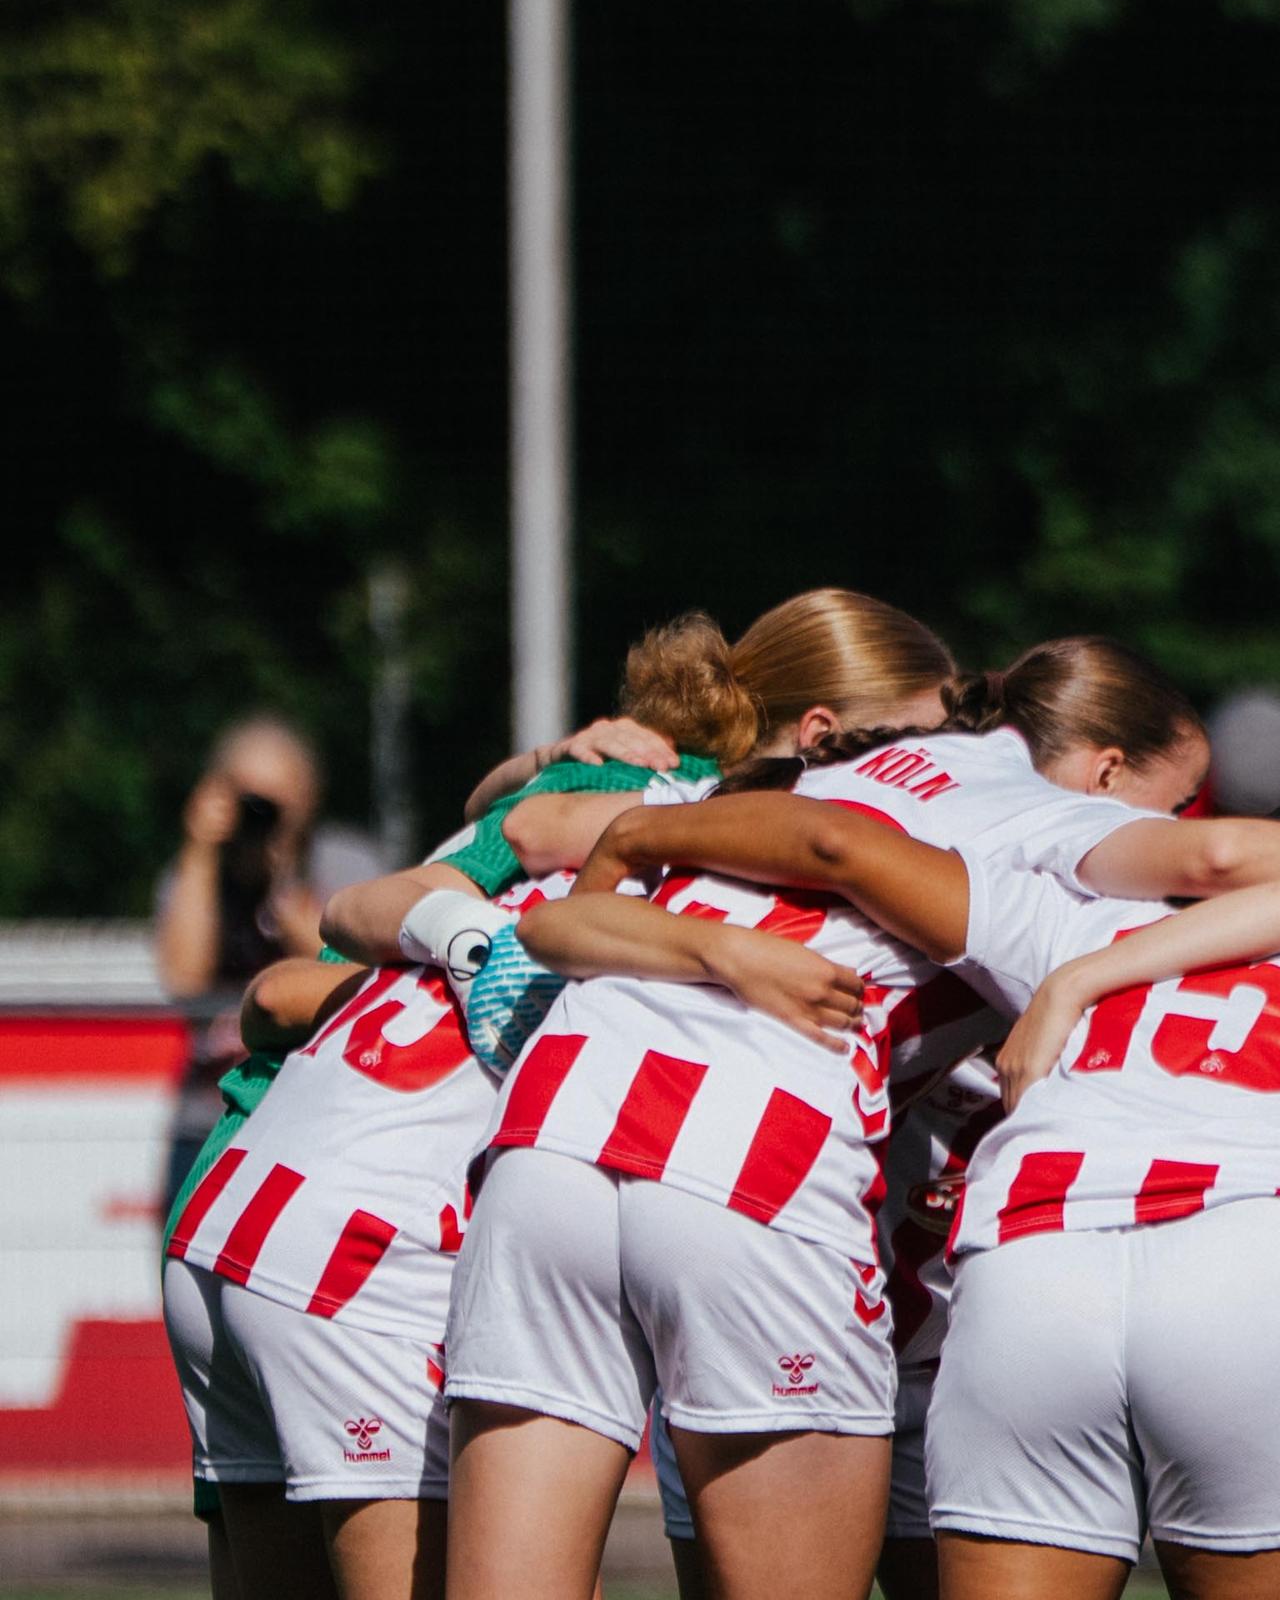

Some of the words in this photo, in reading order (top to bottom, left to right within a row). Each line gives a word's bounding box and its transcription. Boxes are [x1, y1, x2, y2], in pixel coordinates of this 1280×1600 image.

[854, 747, 962, 803] KÖLN
[771, 1382, 820, 1398] hummel
[343, 1448, 391, 1463] hummel
